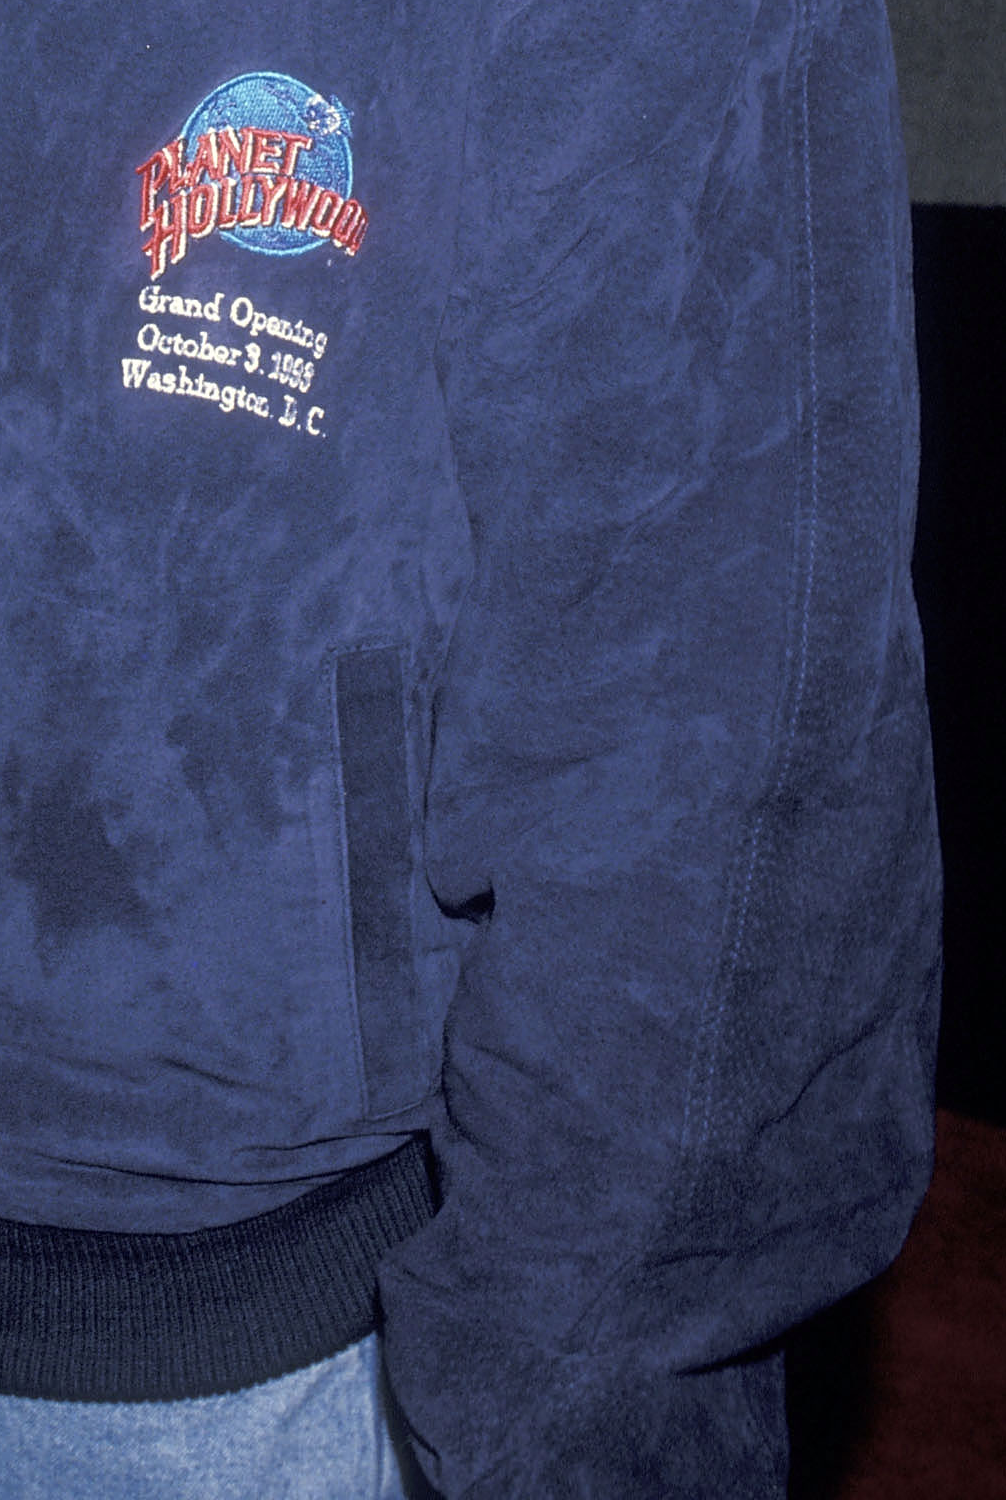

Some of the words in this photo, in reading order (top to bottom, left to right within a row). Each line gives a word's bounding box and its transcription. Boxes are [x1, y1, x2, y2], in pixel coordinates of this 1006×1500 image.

[136, 127, 312, 231] PLANET
[141, 175, 369, 280] HOLLYWOOD
[137, 323, 242, 366] October
[139, 285, 225, 322] Grand
[230, 297, 328, 359] Opening
